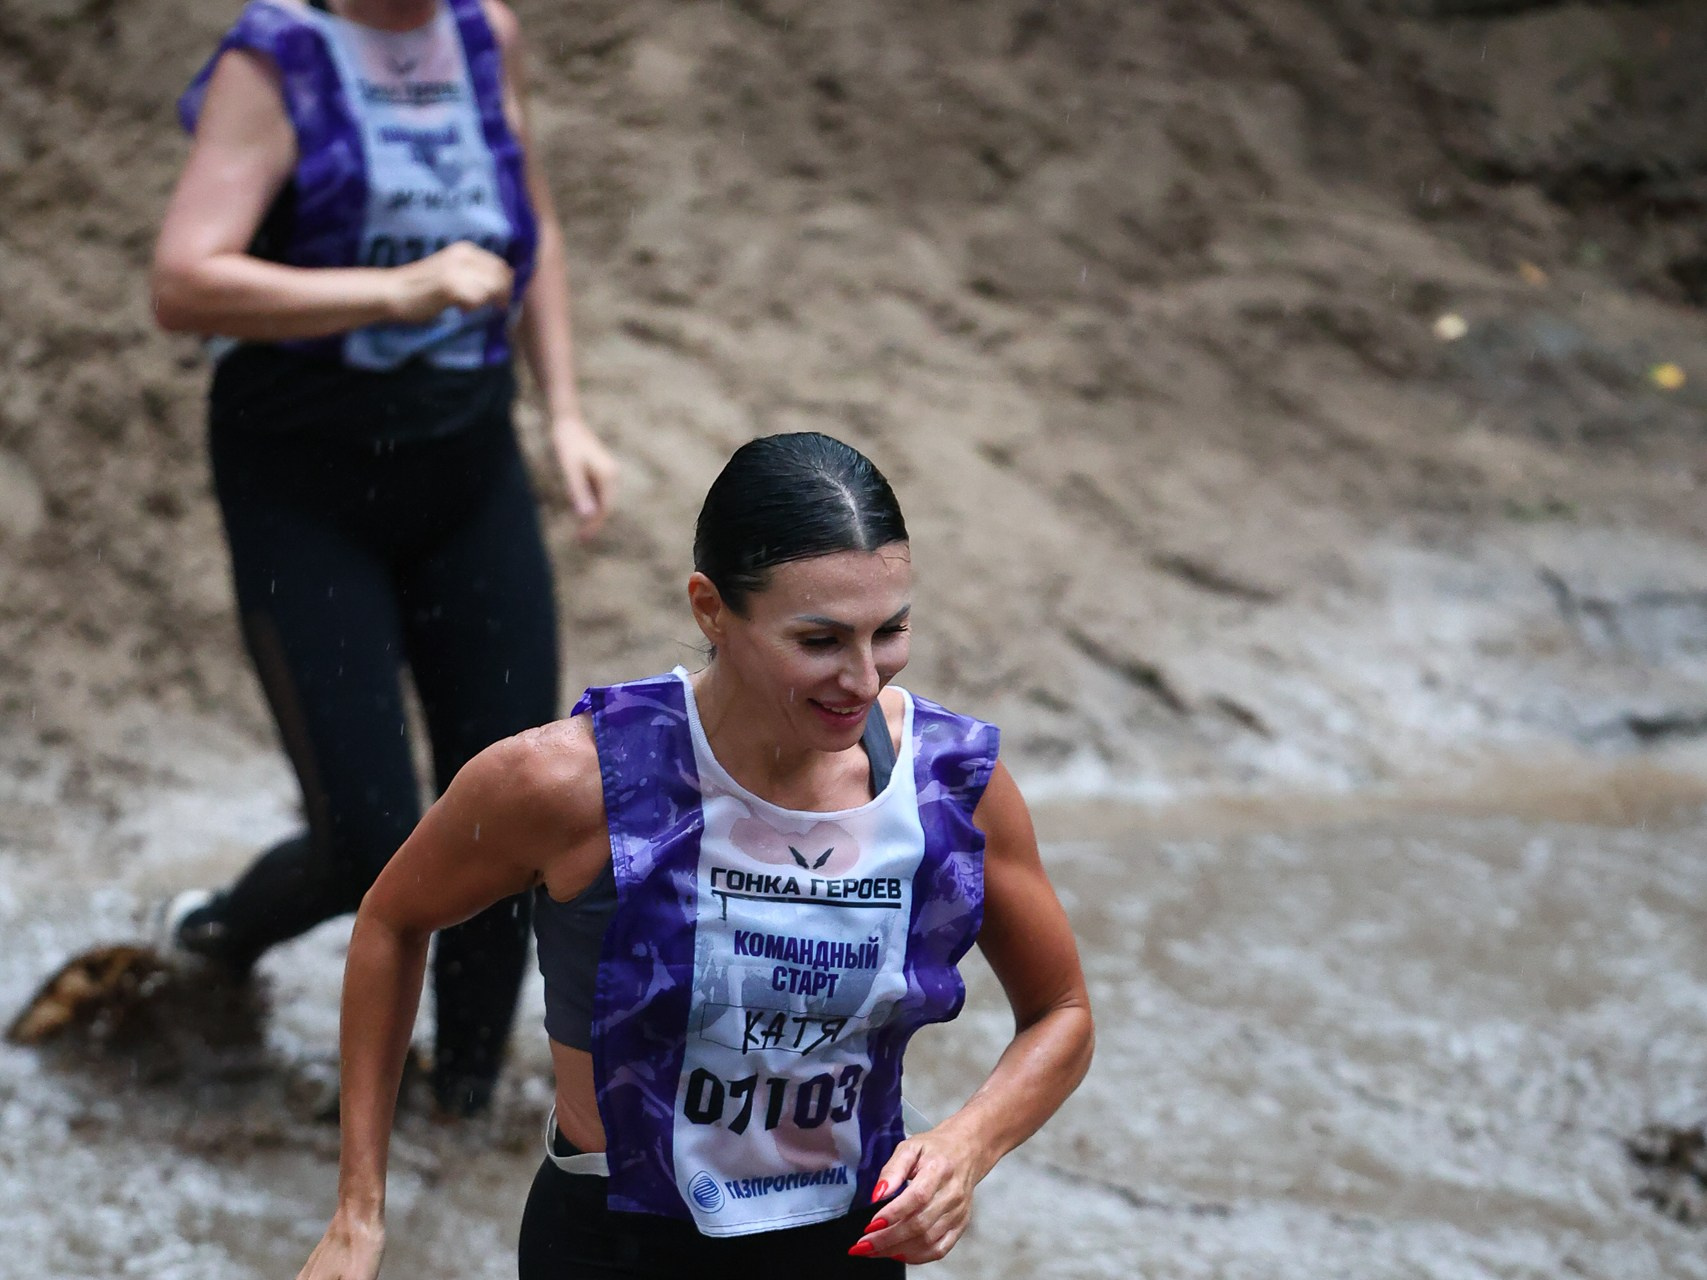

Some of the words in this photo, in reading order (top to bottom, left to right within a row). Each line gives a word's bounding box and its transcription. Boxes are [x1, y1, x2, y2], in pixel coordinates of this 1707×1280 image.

[710, 867, 800, 895] ГОНКА
[810, 878, 902, 899] ГЕРОЕВ
[734, 930, 880, 970] КОМАНДНЫЙ
[772, 966, 839, 998] СТАРТ
[742, 1010, 848, 1056] КАТЯ
[683, 1064, 864, 1135] 07103
[724, 1165, 849, 1200] ГАЗПРОМБАНК
